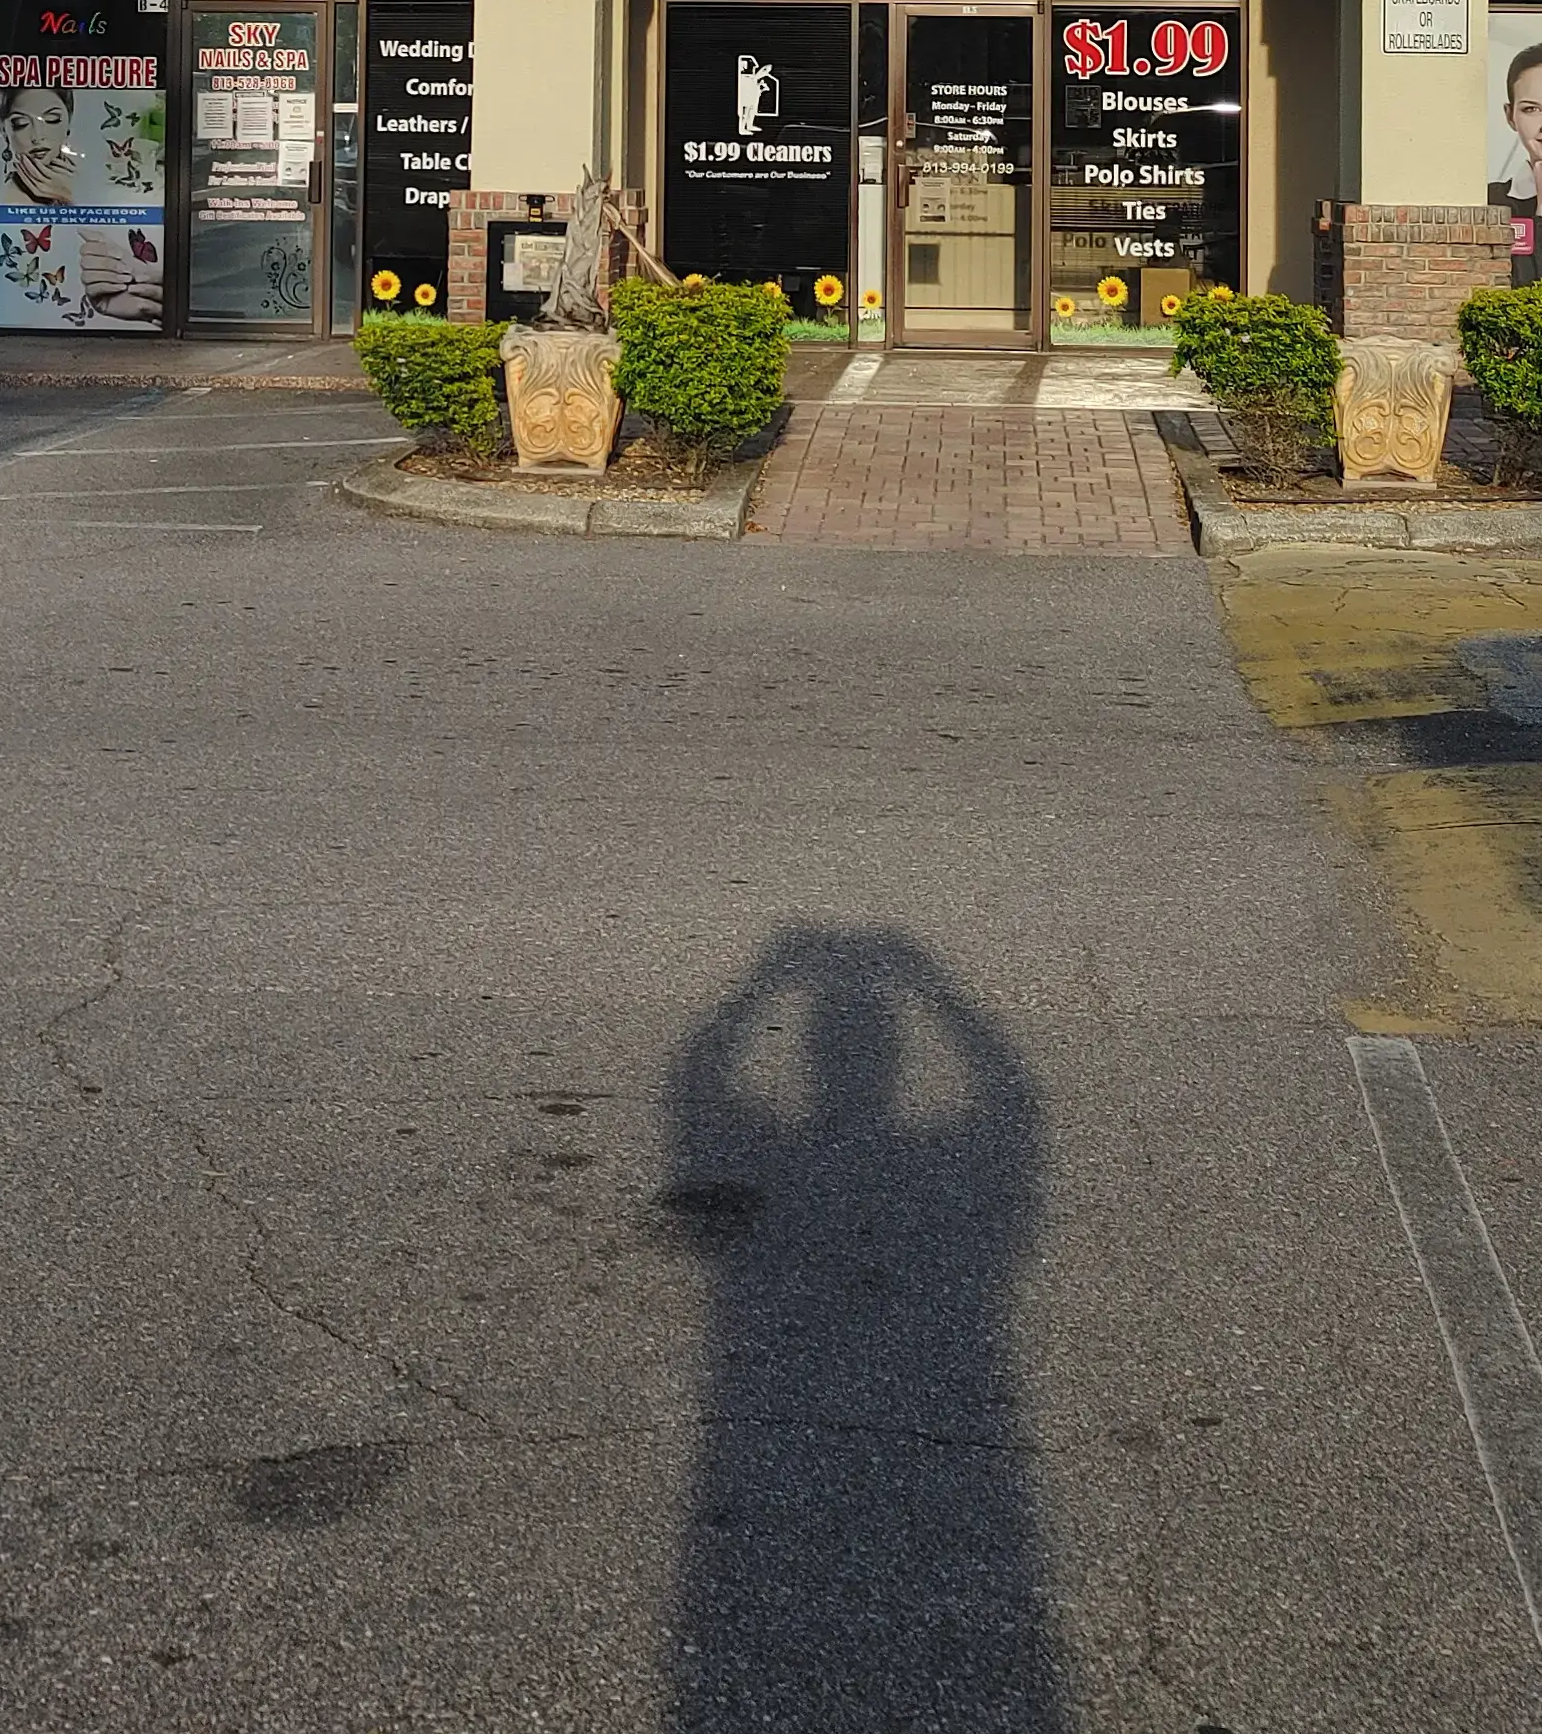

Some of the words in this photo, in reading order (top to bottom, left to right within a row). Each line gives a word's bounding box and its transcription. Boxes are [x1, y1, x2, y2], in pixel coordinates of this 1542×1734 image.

[40, 11, 107, 34] Nails
[1419, 11, 1433, 27] OR
[229, 22, 281, 46] SKY
[1389, 33, 1462, 49] ROLLERBLADES
[380, 40, 463, 62] Wedding
[1063, 19, 1228, 79] $1.99
[199, 49, 253, 69] NAILS
[255, 49, 271, 69] &
[273, 49, 309, 70] SPA
[46, 56, 157, 88] PEDICURE
[931, 85, 966, 95] STORE
[968, 85, 1008, 96] HOURS
[932, 101, 970, 112] Monday
[977, 102, 1007, 113] Friday
[1102, 91, 1188, 111] Blouses
[377, 115, 457, 133] Leathers
[948, 132, 990, 143] Saturday
[1113, 128, 1177, 148] Skirts
[400, 153, 451, 170] Table
[684, 141, 741, 163] $1.99
[746, 142, 832, 163] Cleaners
[706, 171, 754, 179] Customers
[770, 171, 786, 179] Our
[1085, 164, 1134, 186] Polo
[1139, 165, 1205, 185] Shirts
[1122, 201, 1166, 220] Ties
[1114, 237, 1175, 257] Vests
